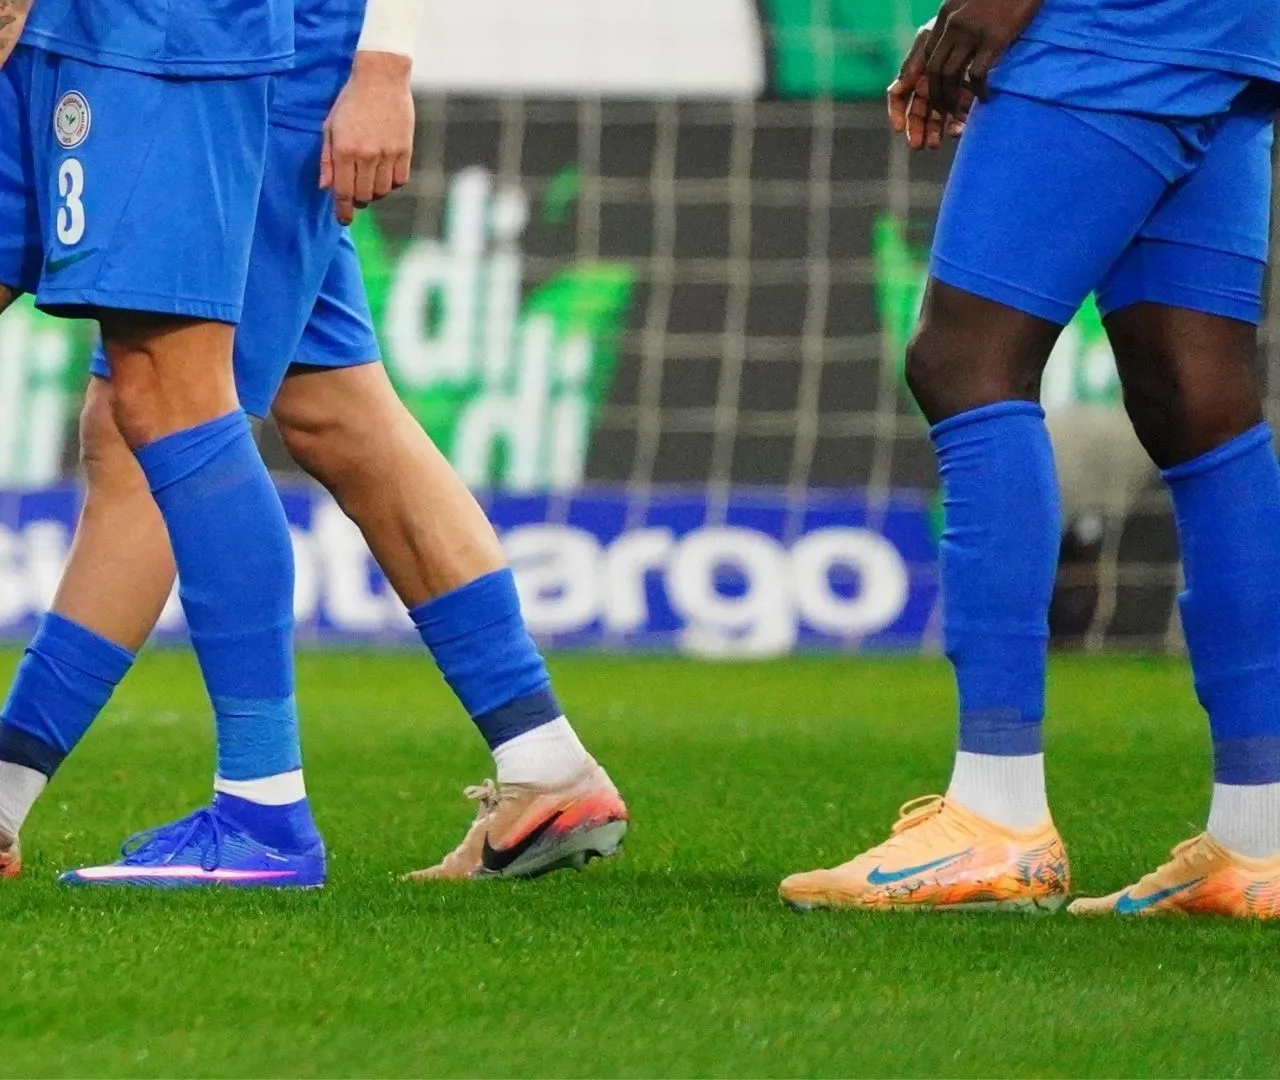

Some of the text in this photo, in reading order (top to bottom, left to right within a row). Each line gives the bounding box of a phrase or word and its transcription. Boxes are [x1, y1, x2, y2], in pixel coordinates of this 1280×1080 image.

[56, 158, 85, 246] 3
[384, 164, 532, 386] di
[452, 314, 590, 494] di
